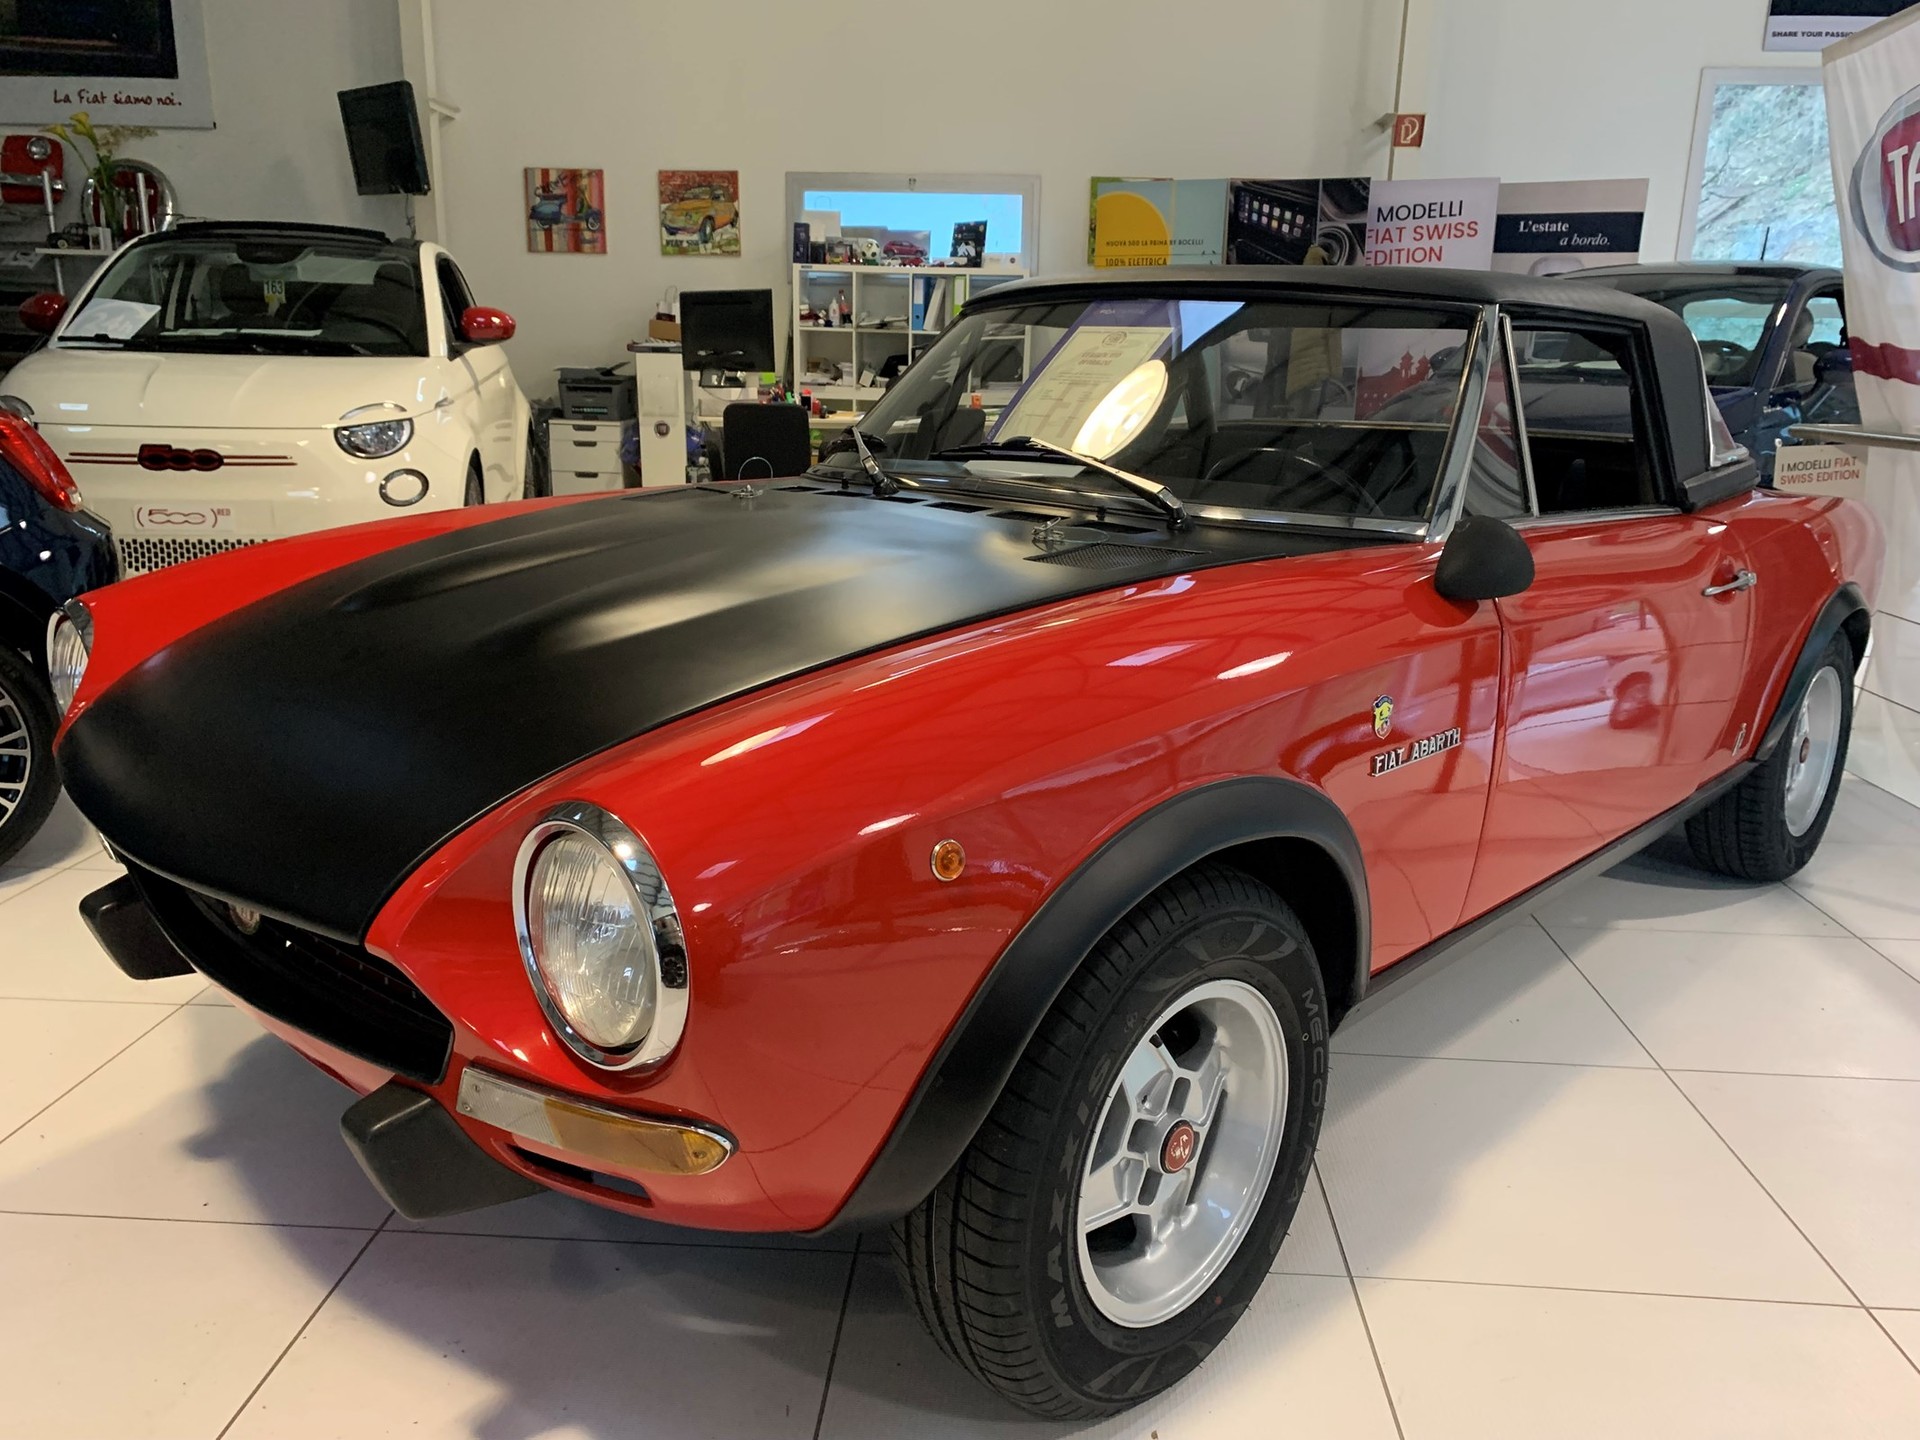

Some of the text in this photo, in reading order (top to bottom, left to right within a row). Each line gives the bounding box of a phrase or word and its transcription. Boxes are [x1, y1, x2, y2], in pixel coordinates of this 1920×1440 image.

[53, 88, 182, 106] La Fiat siamo noi.
[1376, 200, 1463, 223] MODELLI
[1412, 220, 1479, 242] SWISS
[1519, 220, 1569, 233] L'estate
[1106, 239, 1127, 247] NUOVA
[1559, 233, 1611, 246] a bordo.
[1105, 257, 1168, 267] 100% ELETTRICA
[137, 443, 225, 471] 500
[1787, 459, 1832, 472] MODELLI
[1834, 456, 1858, 468] FIAT
[1780, 469, 1860, 485] SWISS EDITION
[1373, 728, 1461, 776] FIAT ABARTH
[1048, 1053, 1112, 1330] MAXXIS
